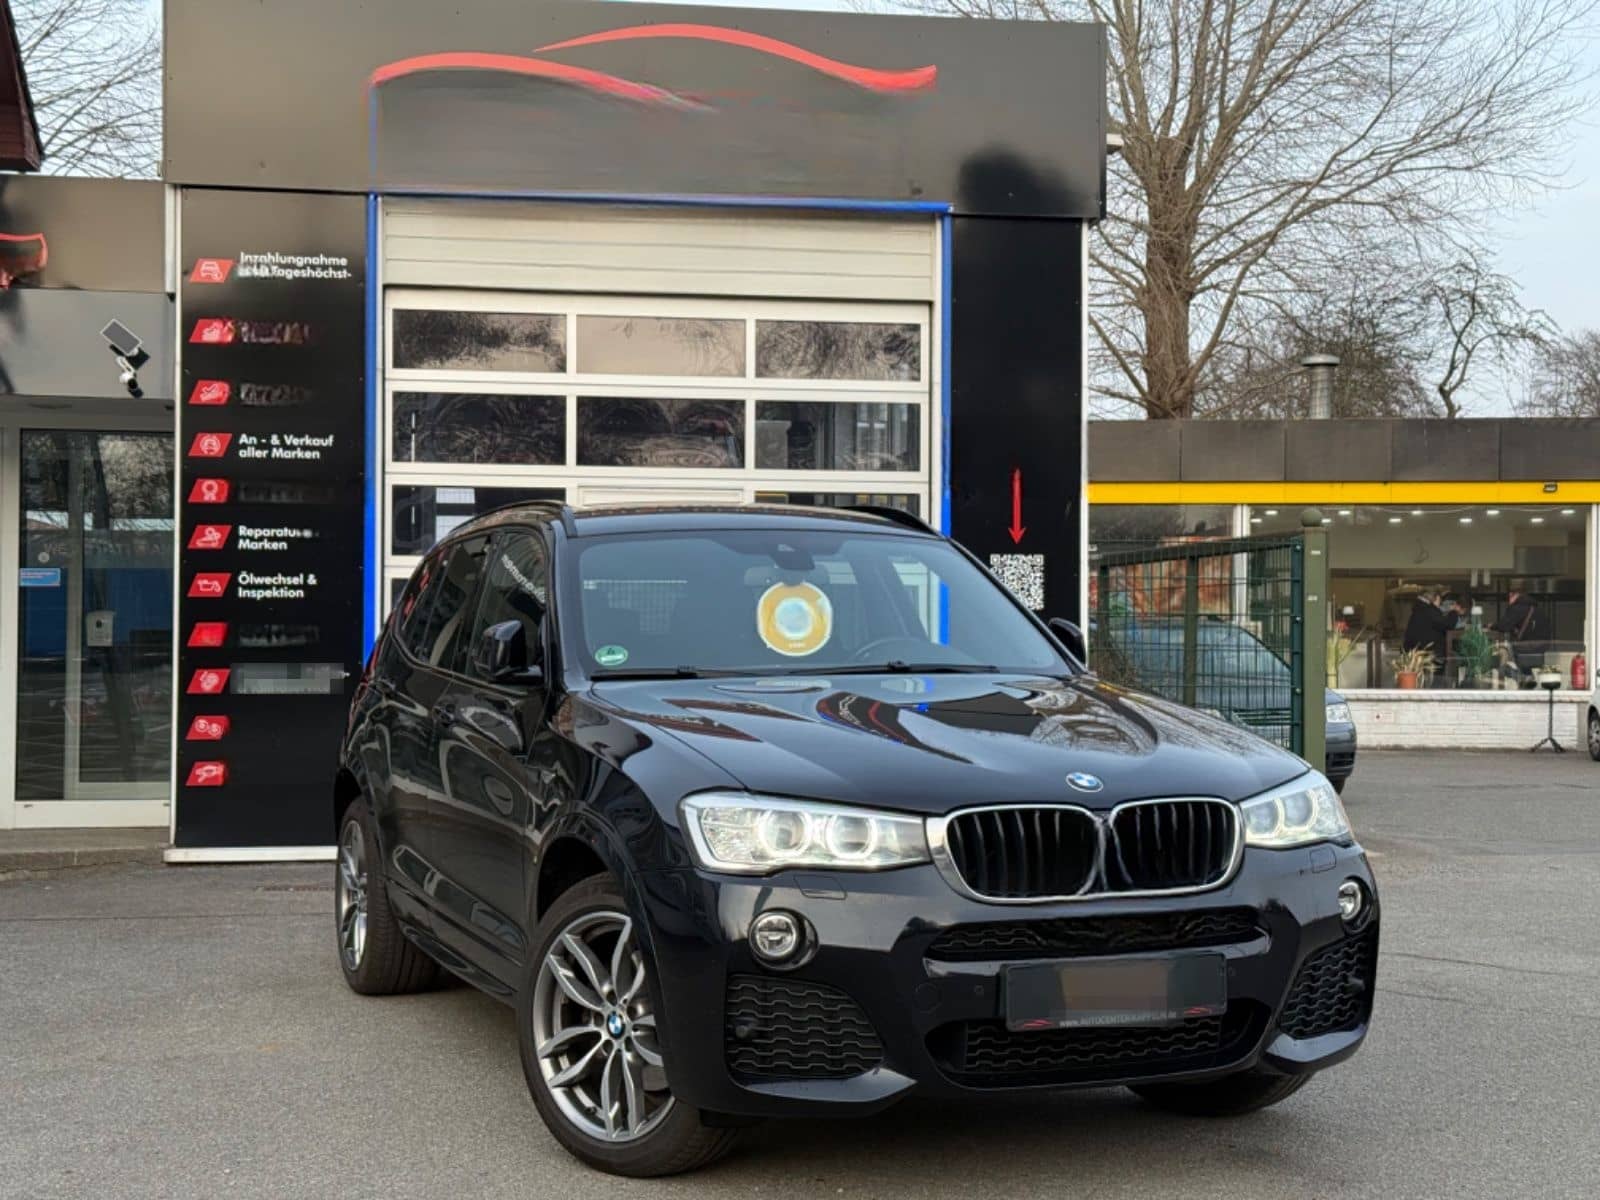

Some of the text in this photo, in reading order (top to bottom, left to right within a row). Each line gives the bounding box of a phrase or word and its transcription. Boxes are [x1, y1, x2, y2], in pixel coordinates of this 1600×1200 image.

[240, 251, 348, 267] Inzahlungnahme
[239, 433, 258, 445] An
[270, 434, 280, 446] &
[283, 434, 334, 447] Verkauf
[239, 446, 320, 459] aller Marken
[238, 539, 288, 550] Marken
[238, 570, 317, 585] Ölwechsel &
[238, 586, 305, 601] Inspektion
